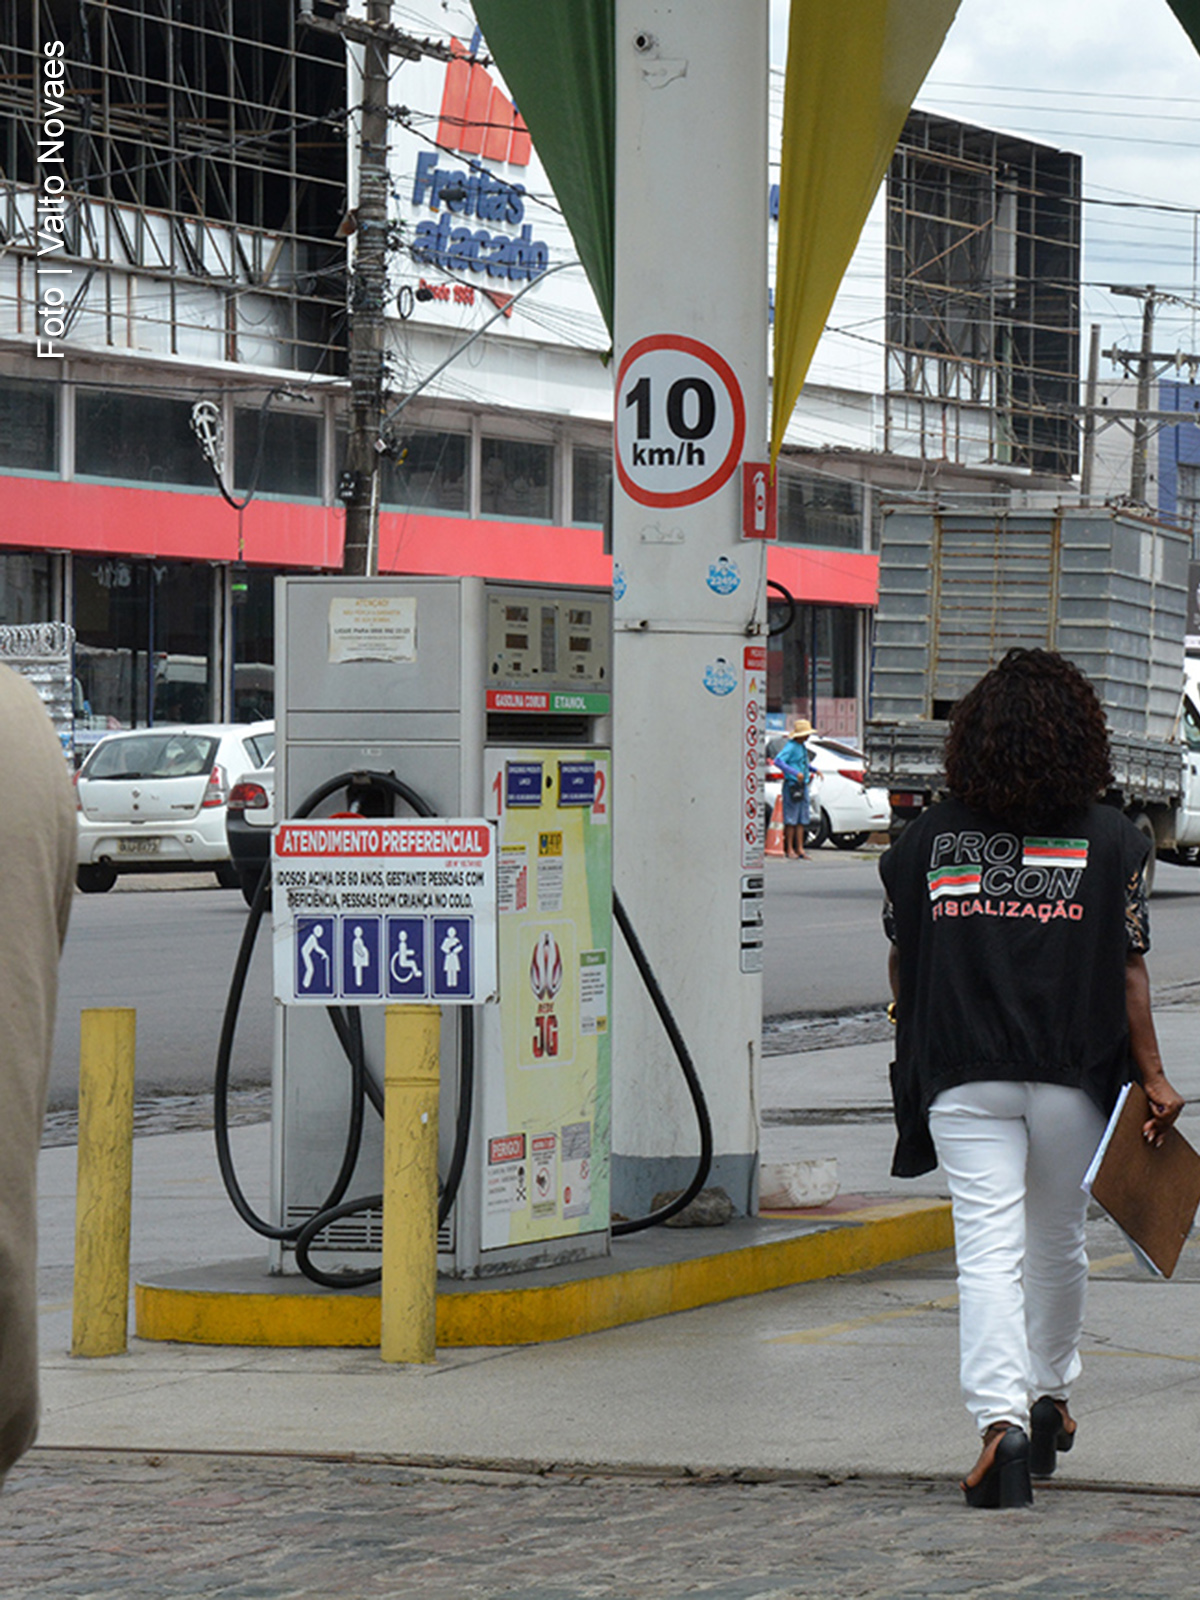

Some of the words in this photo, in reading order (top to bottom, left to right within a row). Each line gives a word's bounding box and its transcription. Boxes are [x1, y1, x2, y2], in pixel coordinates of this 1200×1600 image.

[412, 151, 526, 225] Freitas
[412, 212, 549, 281] atacado
[626, 377, 716, 440] 10
[632, 442, 705, 466] km/h
[495, 694, 523, 707] GASOLINA
[554, 696, 587, 709] ETANOL
[492, 771, 502, 816] 1
[593, 770, 606, 814] 2
[282, 830, 379, 852] ATENDIMENTO
[381, 830, 482, 853] PREFERENCIAL
[930, 831, 1019, 868] PRO
[278, 871, 306, 886] IDOSOS
[309, 871, 333, 886] ACIMA
[336, 871, 346, 886] DE
[348, 871, 358, 886] 60
[361, 871, 384, 889] ANOS,
[386, 871, 426, 886] GESTANTE
[428, 871, 463, 886] PESSOAS
[465, 871, 485, 886] COM
[982, 865, 1083, 900] CON
[288, 890, 340, 910] DEFICIÊNCIA,
[341, 893, 377, 908] PESSOAS
[379, 893, 397, 908] COM
[398, 893, 432, 910] CRIANÇA
[434, 893, 447, 908] NO
[449, 893, 473, 908] COLO.
[932, 899, 1084, 923] FISCALIZAÇÃO
[533, 1014, 558, 1058] JG
